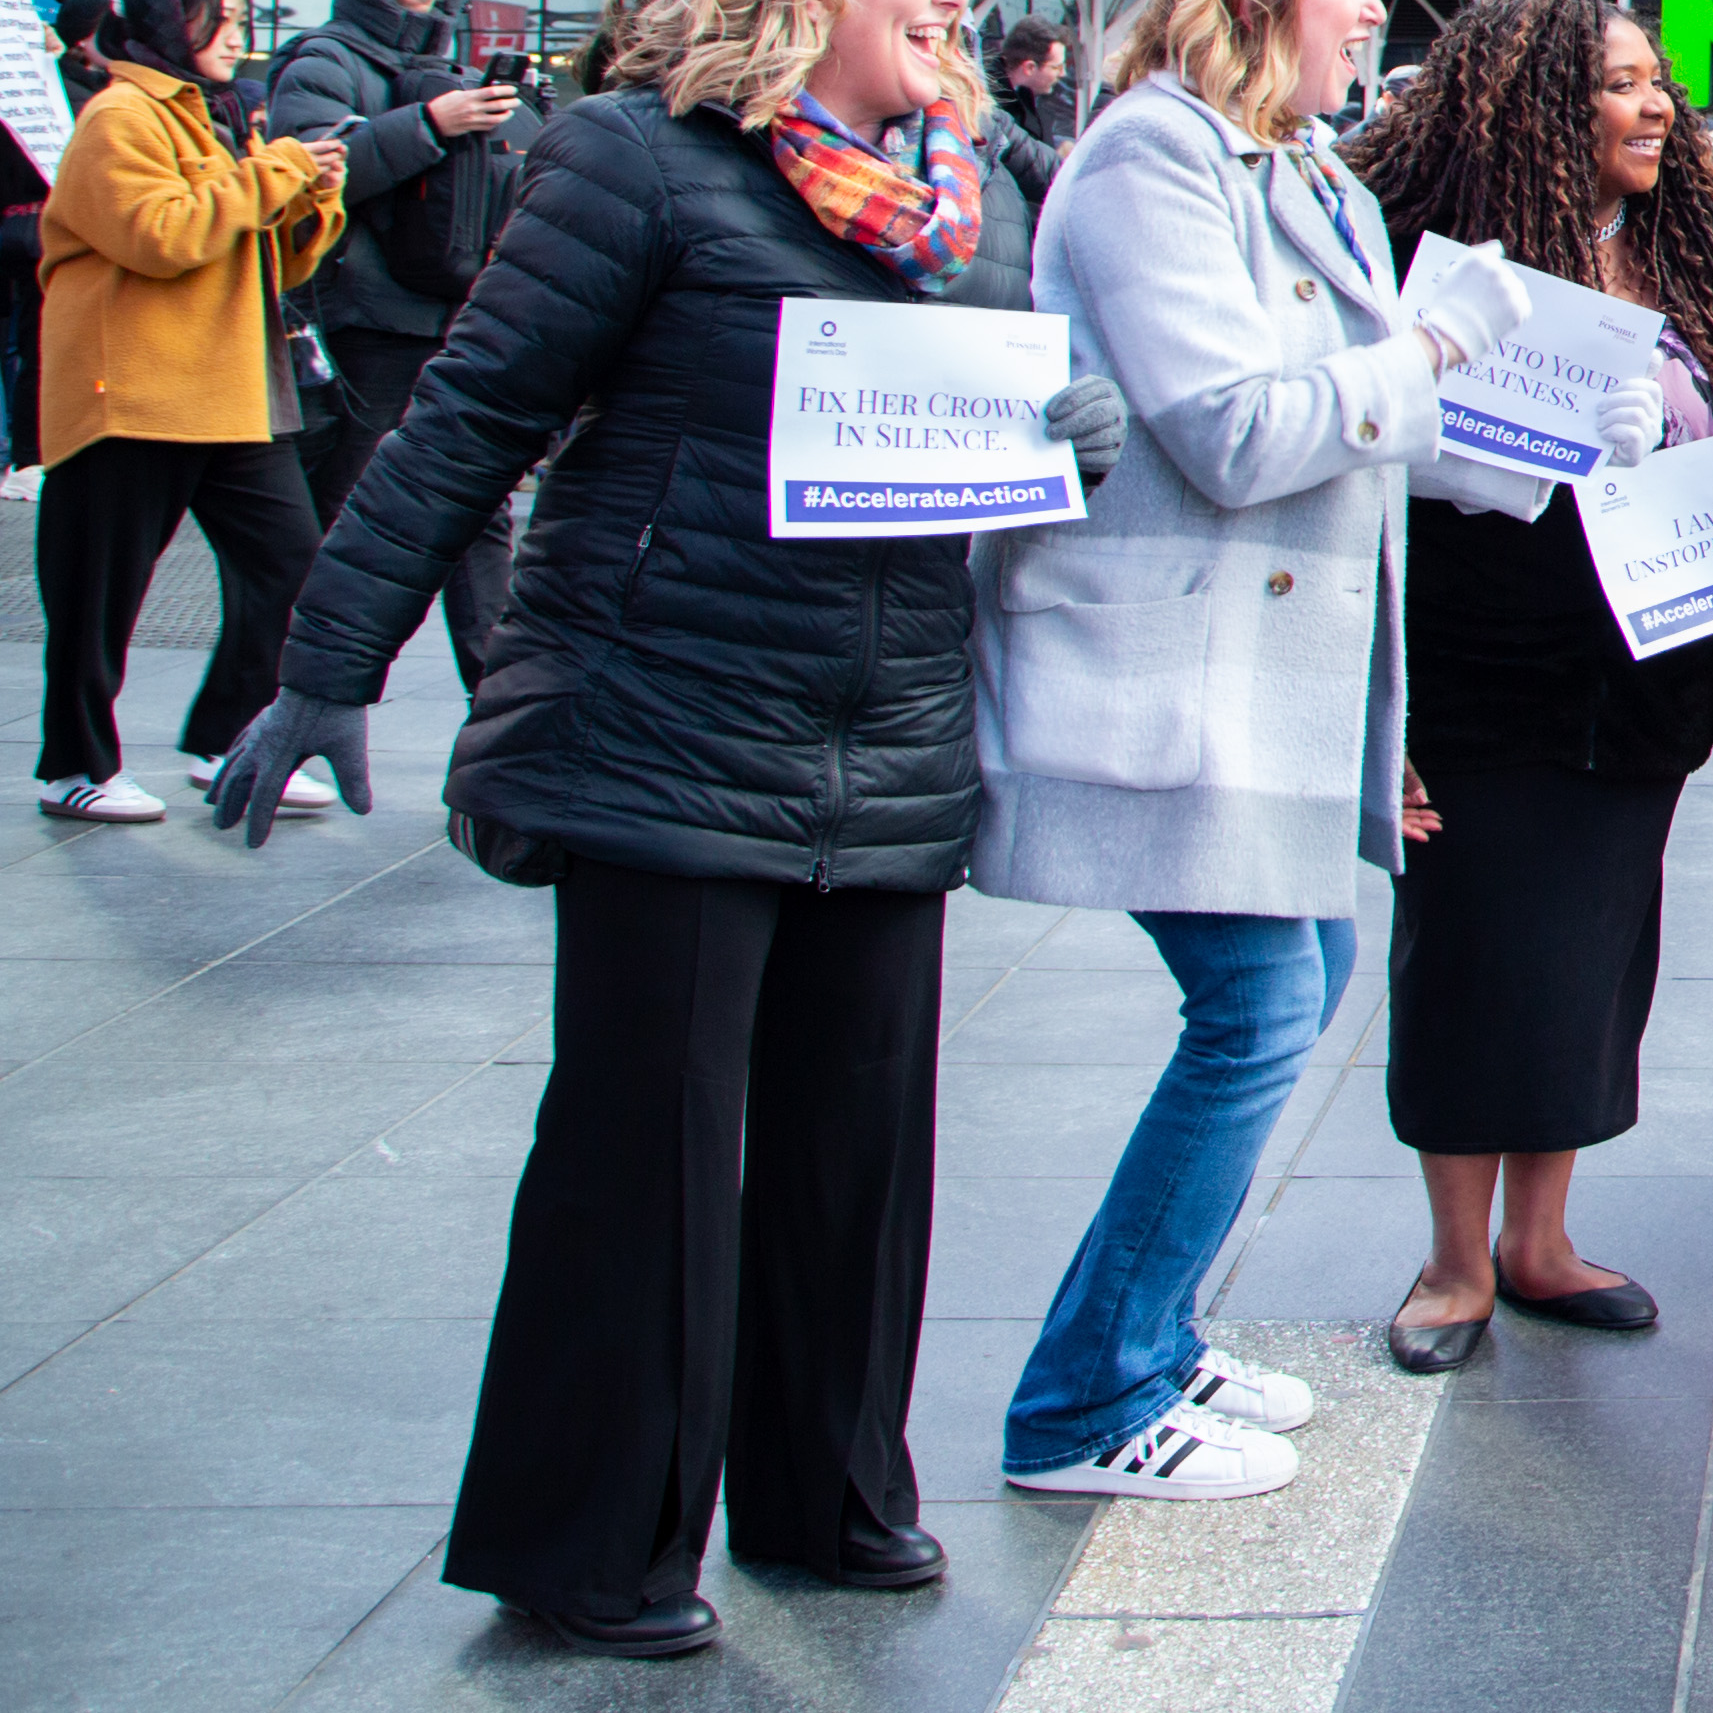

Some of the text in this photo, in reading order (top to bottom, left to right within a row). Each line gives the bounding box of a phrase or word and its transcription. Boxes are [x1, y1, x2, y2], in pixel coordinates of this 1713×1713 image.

[1598, 320, 1638, 340] POSSIBLE
[1488, 339, 1544, 370] NTO
[1452, 358, 1580, 413] EATNESS.
[798, 386, 1043, 422] FIX HER CROWN
[834, 422, 1008, 452] IN SILENCE.
[1440, 407, 1582, 464] elerateAction
[804, 485, 1047, 509] #AccelerateAction
[1673, 518, 1682, 539] I
